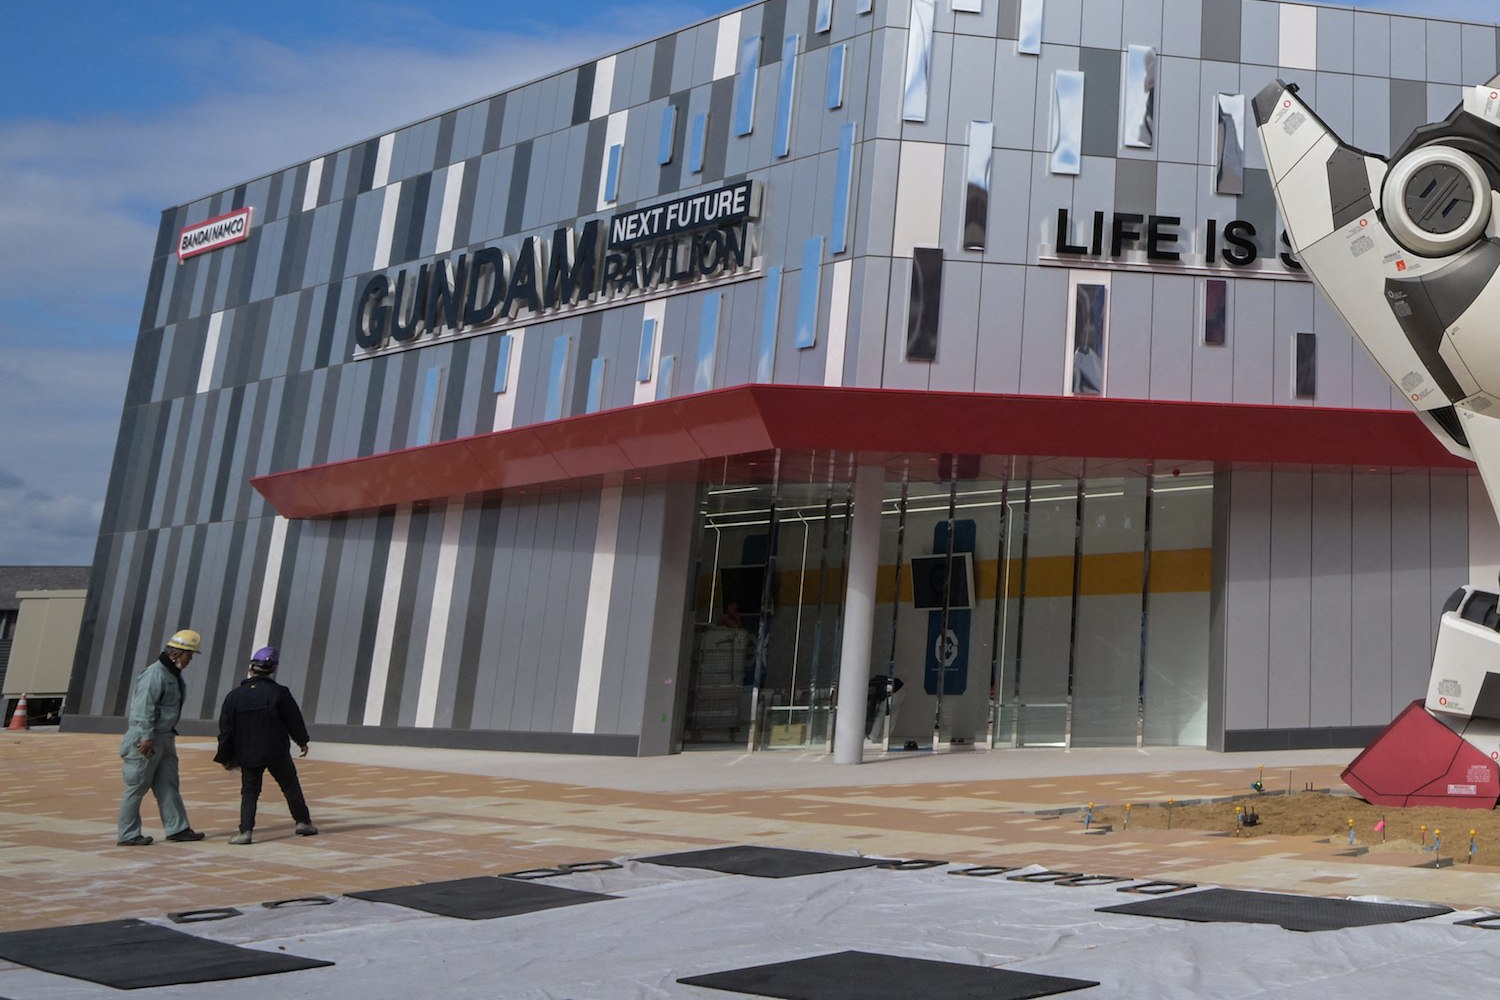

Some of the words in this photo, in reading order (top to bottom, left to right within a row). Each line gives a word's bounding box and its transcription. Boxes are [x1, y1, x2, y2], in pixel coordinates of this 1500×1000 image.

[181, 228, 213, 250] BANDAI
[212, 217, 244, 241] NAMCO
[612, 207, 664, 244] NEXT
[665, 185, 748, 231] FUTURE
[1056, 208, 1181, 261] LIFE
[1205, 219, 1258, 266] IS
[355, 219, 604, 350] GUNDAM
[601, 219, 749, 297] PAVILION
